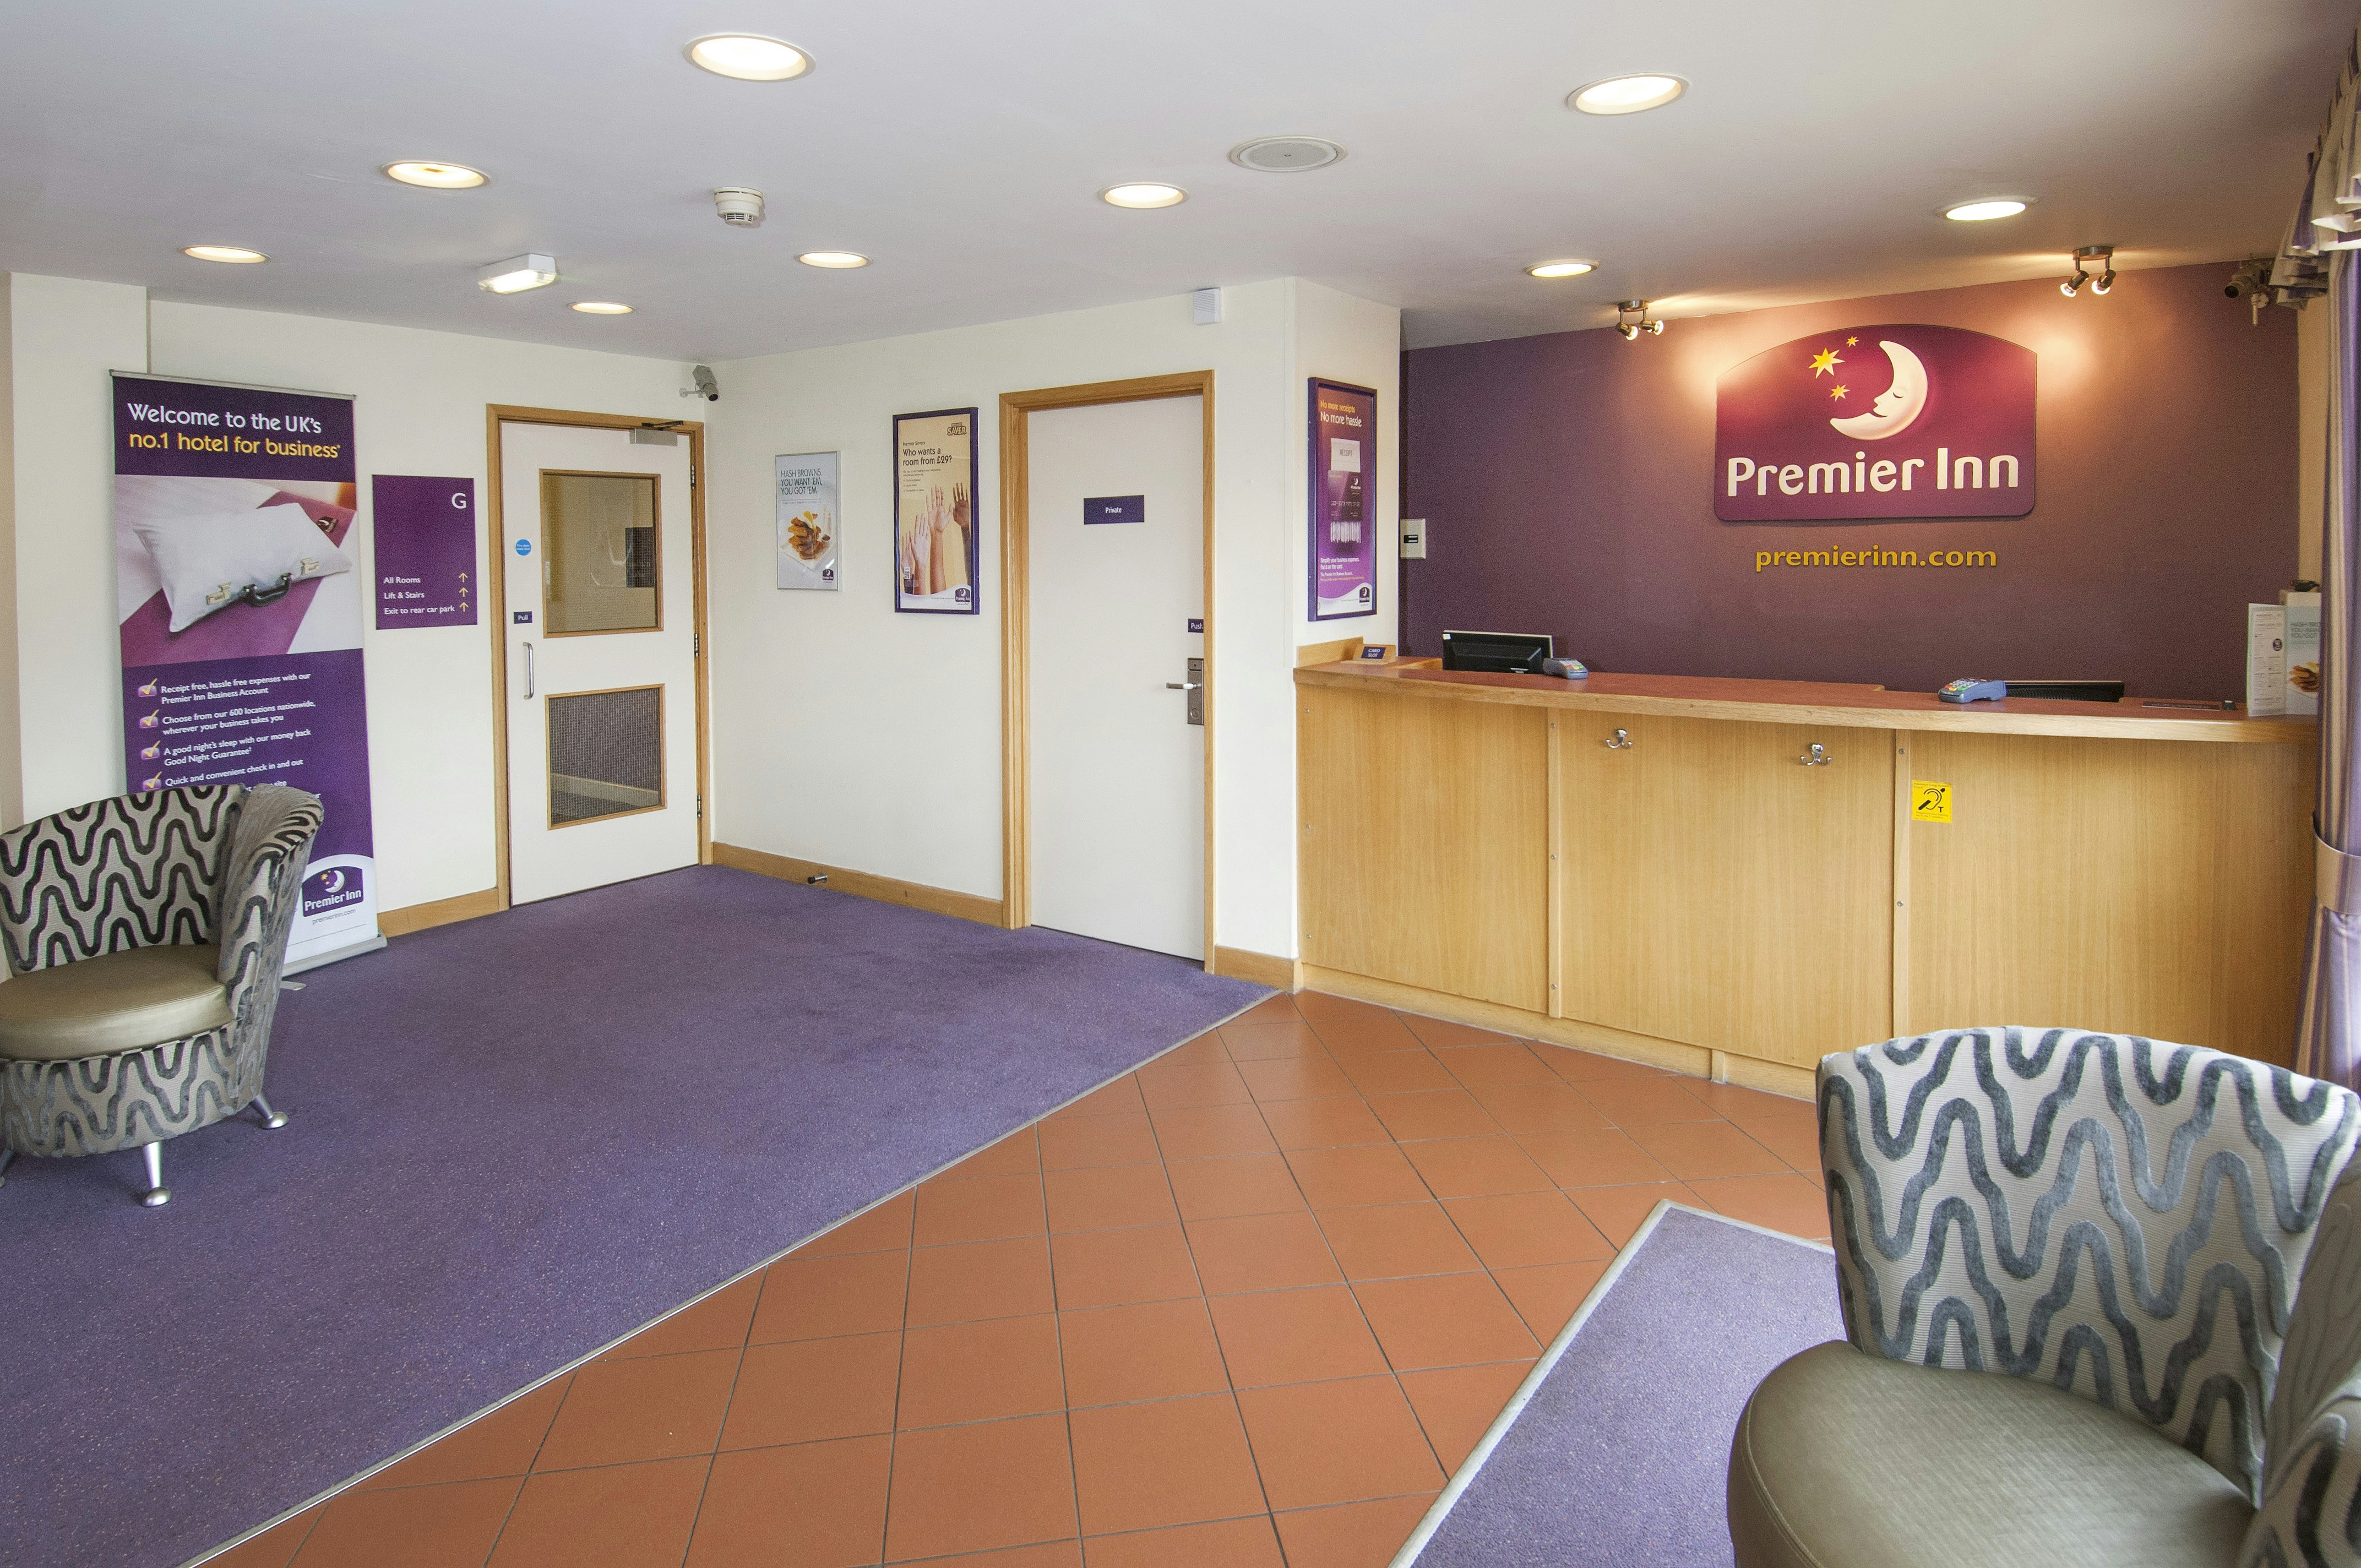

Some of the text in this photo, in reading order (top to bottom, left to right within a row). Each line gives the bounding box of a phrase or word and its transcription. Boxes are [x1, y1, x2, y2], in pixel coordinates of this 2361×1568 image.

[1328, 402, 1339, 411] more
[1339, 405, 1356, 413] receipts
[127, 403, 322, 434] Welcome to the UK's
[1320, 411, 1362, 427] No more hassle
[947, 426, 967, 436] SAVER
[129, 432, 168, 449] no.1
[177, 432, 228, 453] hotel
[233, 436, 260, 454] for
[937, 455, 952, 464] £29?
[781, 470, 796, 478] HASH
[1727, 448, 2019, 497] Premier Inn
[794, 477, 810, 486] WANT
[794, 486, 806, 494] GOT
[451, 493, 466, 509] G
[1755, 545, 1997, 573] premierinn.com
[439, 605, 455, 614] park
[161, 684, 190, 693] Receipt
[209, 680, 232, 688] hassle
[249, 677, 280, 685] expenses
[161, 695, 192, 704] Premier
[239, 688, 269, 696] Account
[162, 716, 192, 724] Choose
[229, 708, 243, 716] 600
[244, 706, 275, 714] locations
[162, 726, 198, 735] wherever
[199, 723, 218, 732] your
[219, 720, 249, 728] business
[172, 744, 192, 756] good
[193, 741, 217, 752] night's
[218, 739, 238, 748] sleep
[238, 736, 255, 744] with
[295, 728, 311, 737] back
[164, 756, 187, 766] Good
[188, 753, 210, 763] Night
[165, 776, 188, 786] Quick
[189, 773, 204, 782] and
[205, 768, 246, 780] convenient
[247, 764, 268, 773] check
[276, 760, 290, 768] and
[304, 890, 361, 911] Premier Inn
[312, 909, 356, 925] premierinn.com
